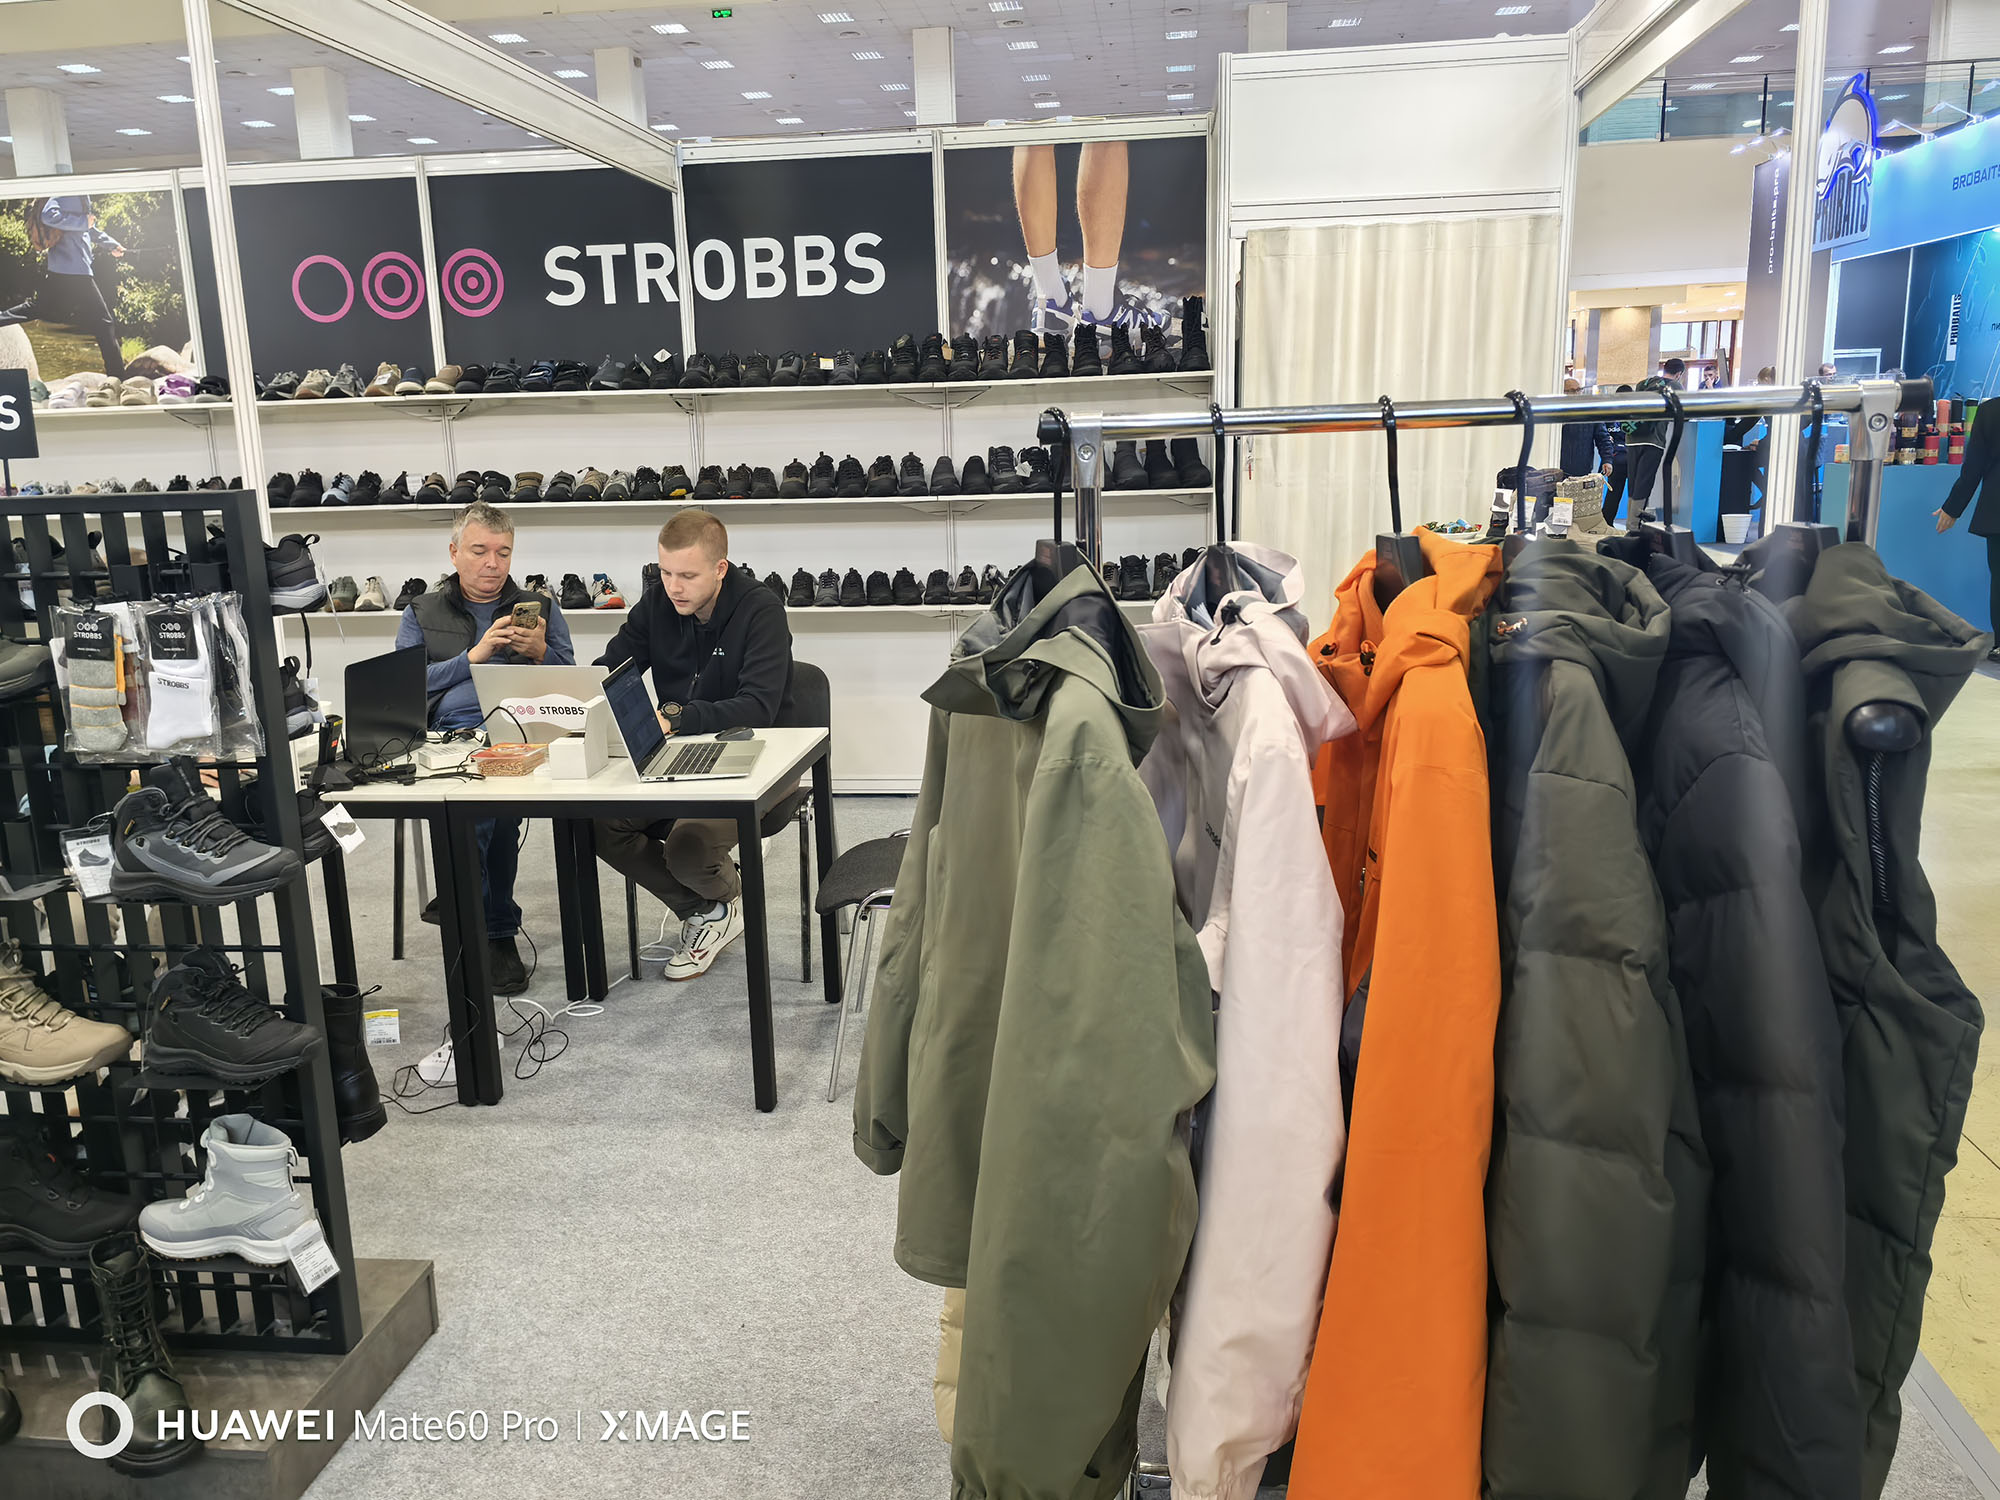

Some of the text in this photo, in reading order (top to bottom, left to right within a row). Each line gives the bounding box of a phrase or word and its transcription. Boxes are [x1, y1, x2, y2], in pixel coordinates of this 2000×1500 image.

[544, 231, 886, 307] STROBBS
[73, 631, 103, 640] STROBBS
[157, 677, 190, 689] STROBBS
[539, 706, 585, 716] STROBBS
